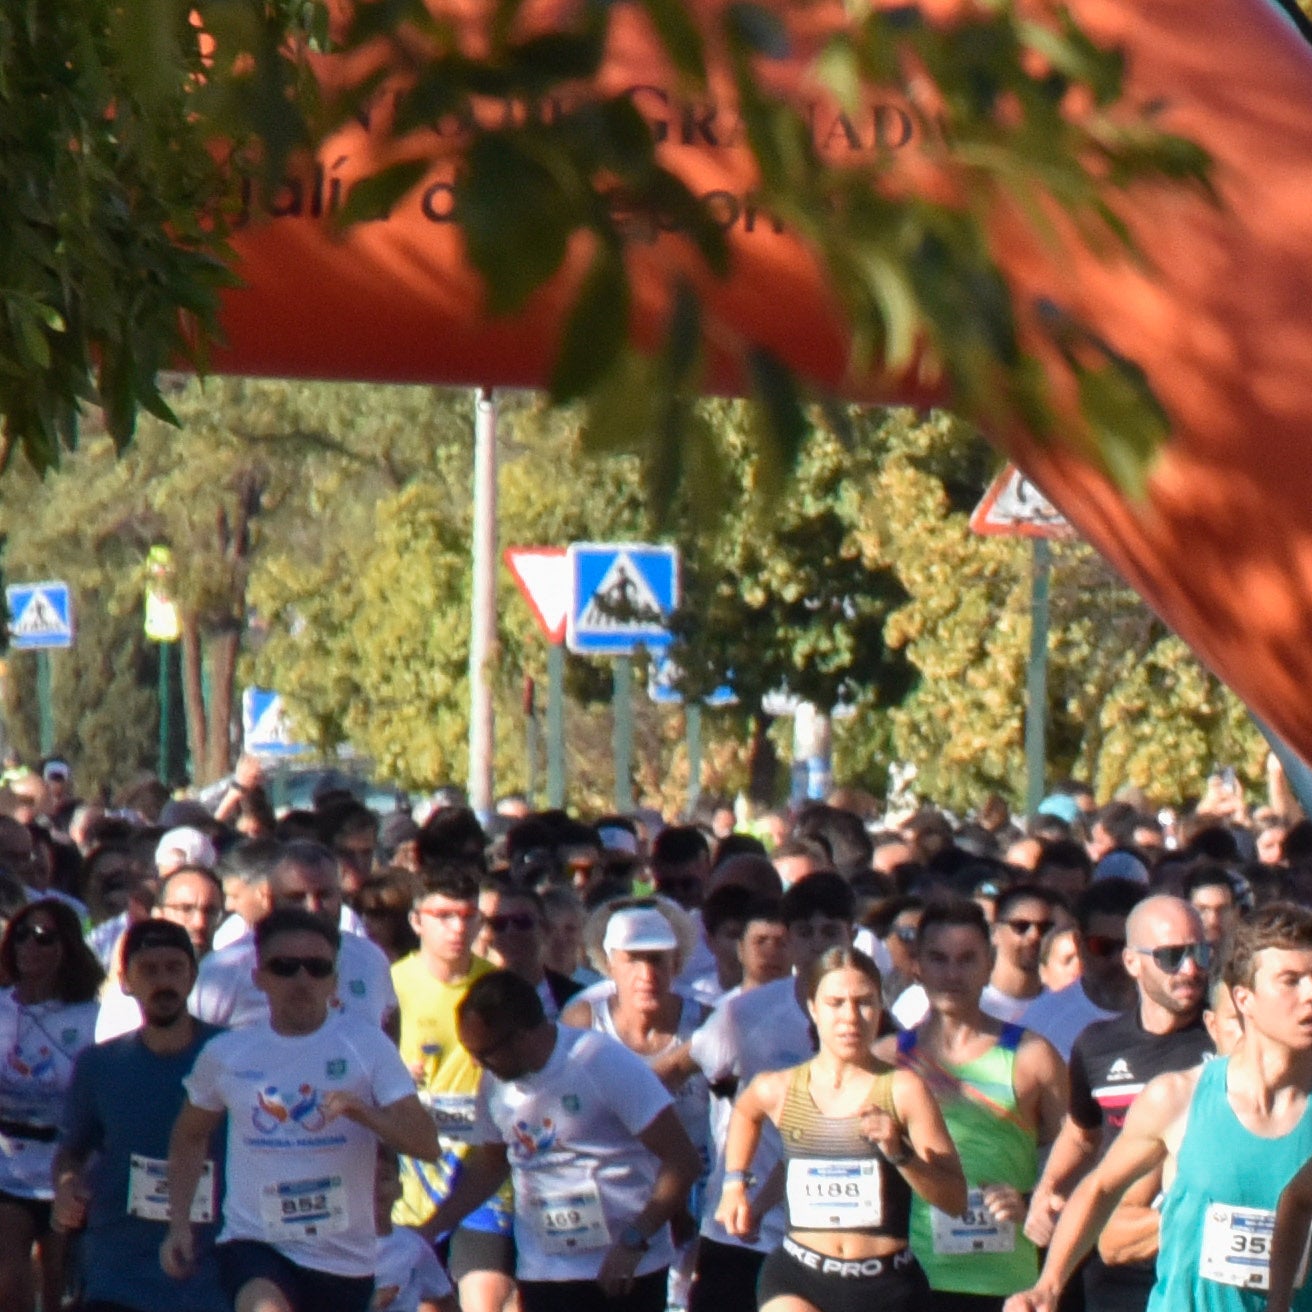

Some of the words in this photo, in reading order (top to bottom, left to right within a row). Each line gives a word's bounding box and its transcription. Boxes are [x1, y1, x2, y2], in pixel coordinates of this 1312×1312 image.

[805, 1182, 860, 1198] 1188
[282, 1194, 326, 1214] 852
[1230, 1234, 1272, 1255] 35
[822, 1258, 883, 1278] PRO
